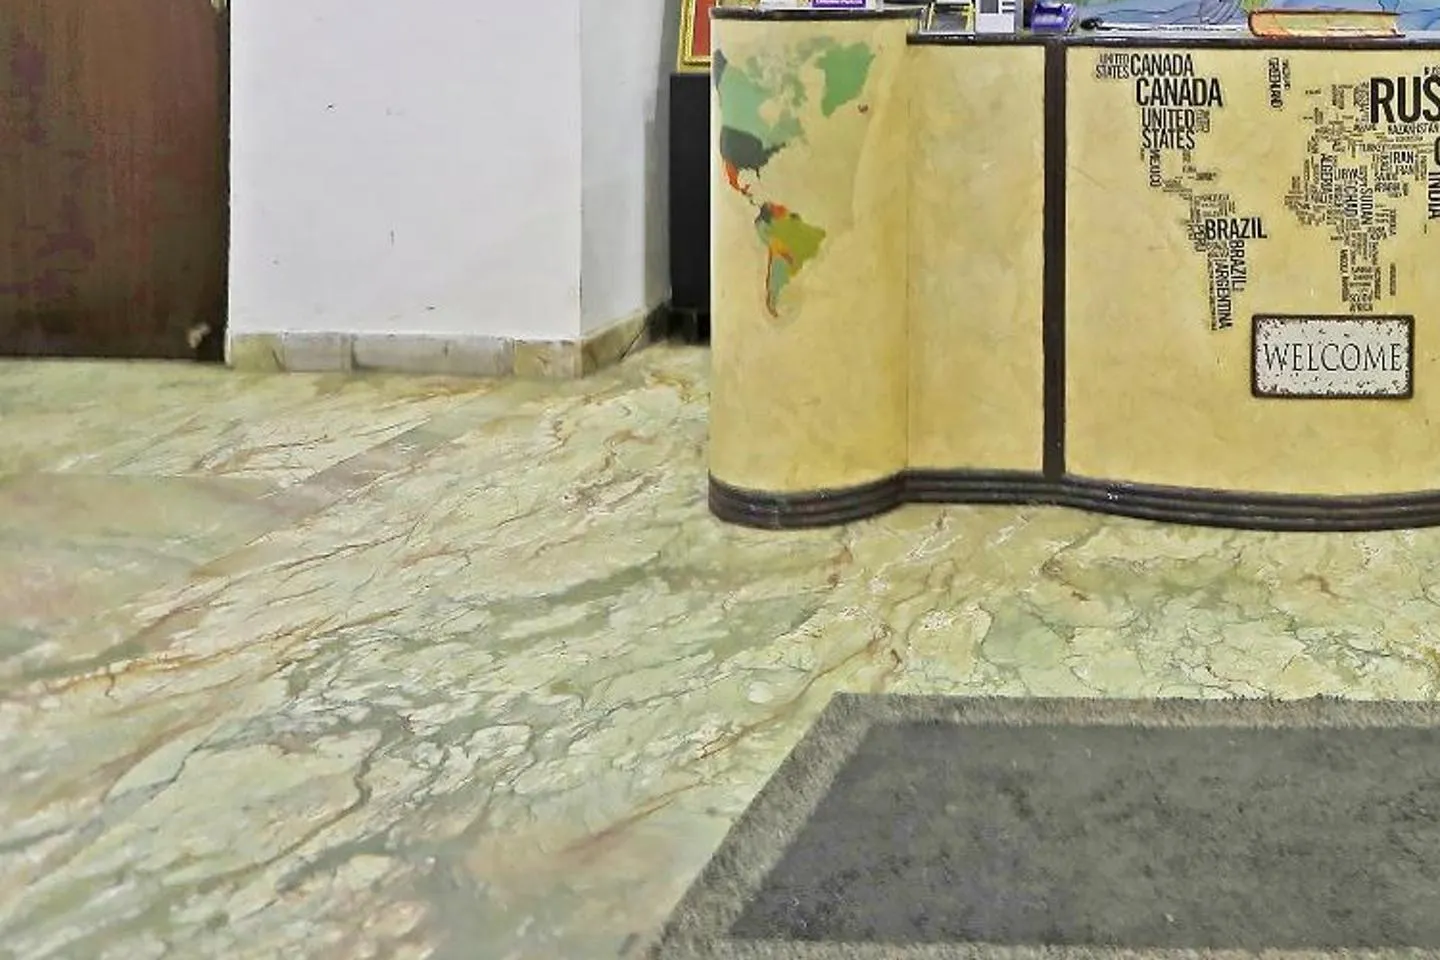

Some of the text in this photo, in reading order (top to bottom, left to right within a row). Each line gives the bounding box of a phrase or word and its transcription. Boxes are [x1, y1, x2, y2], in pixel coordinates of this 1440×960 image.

[1096, 65, 1129, 79] STATES
[1130, 54, 1195, 76] CANADA
[1136, 78, 1223, 107] CANADA
[1142, 107, 1195, 129] UNITED
[1142, 128, 1195, 150] STATES
[1206, 217, 1267, 239] BRAZIL
[1229, 240, 1246, 287] BRAZIL
[1215, 261, 1233, 328] ARGENTINA
[1263, 343, 1403, 372] WELCOME
